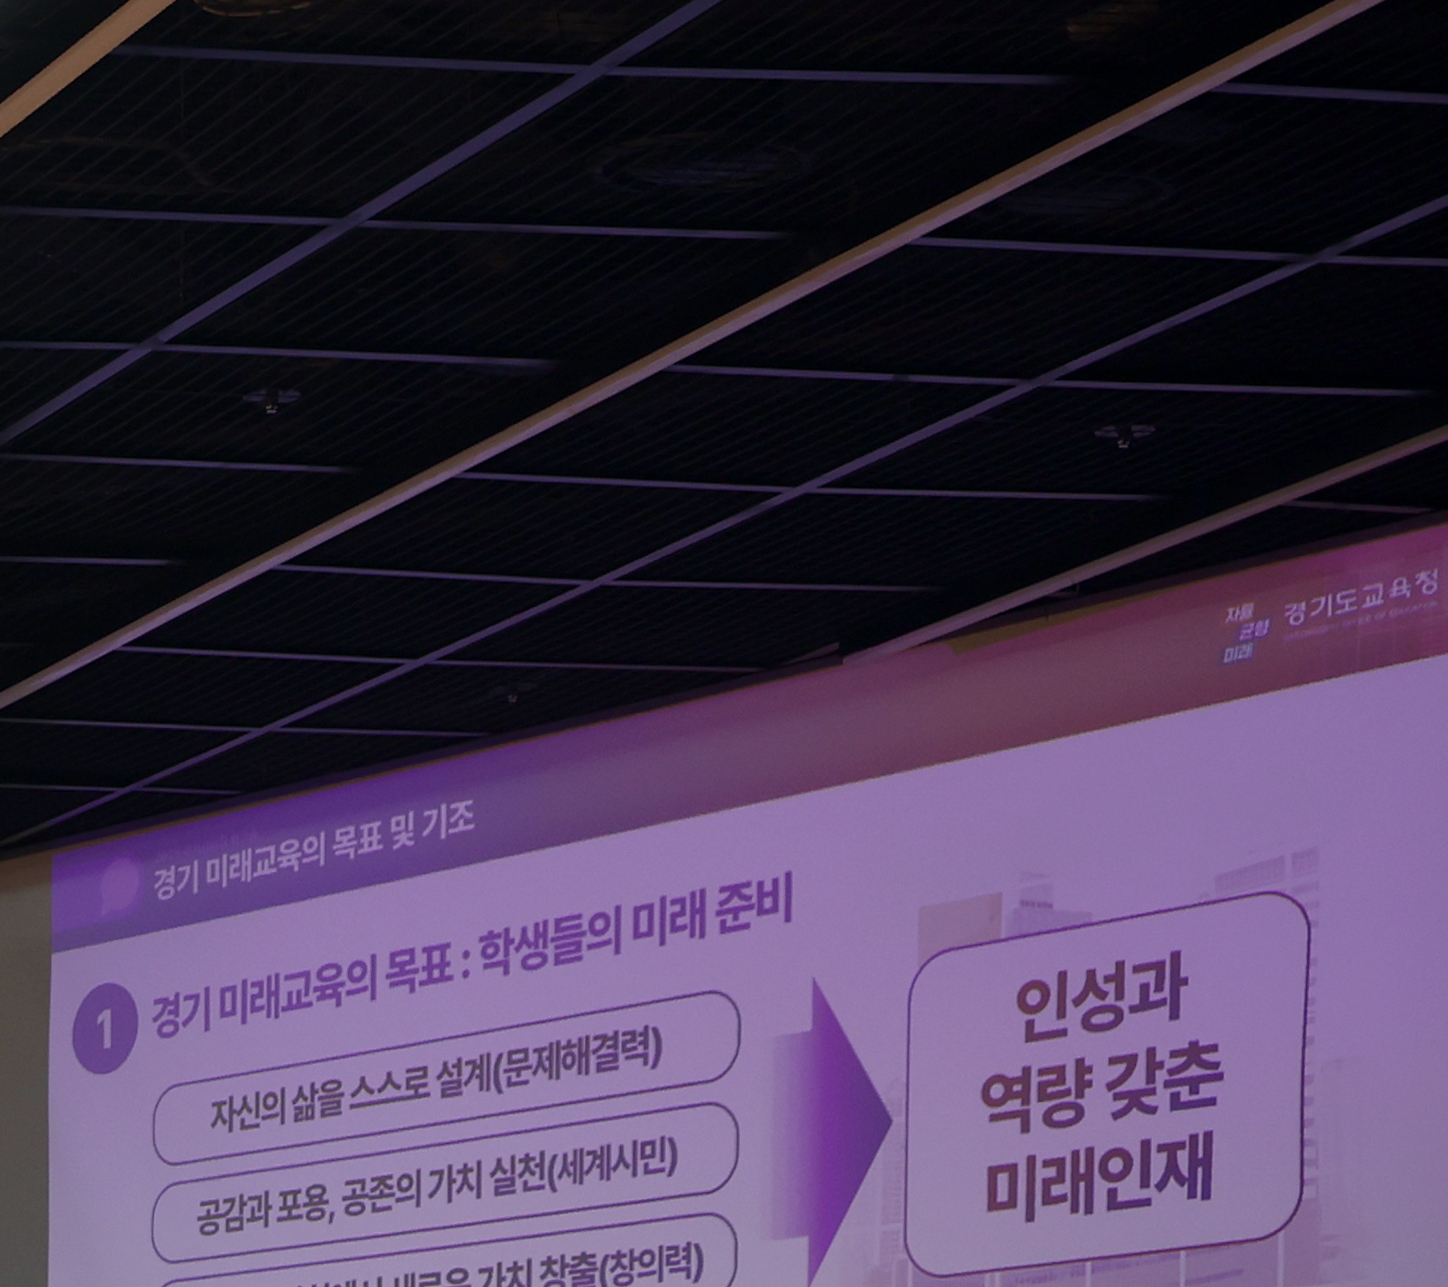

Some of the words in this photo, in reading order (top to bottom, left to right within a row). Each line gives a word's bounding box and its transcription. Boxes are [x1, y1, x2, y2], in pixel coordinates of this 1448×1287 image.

[1284, 568, 1438, 627] 경기도교육청
[154, 860, 199, 900] 경기
[206, 830, 326, 888] 미래교육의
[332, 827, 383, 868] 목표
[389, 817, 417, 851] 및
[423, 801, 476, 842] 기조
[152, 988, 211, 1040] 경기
[219, 953, 379, 1026] 미래교육의
[385, 941, 453, 986] 목표
[479, 904, 623, 977] 학생들의
[632, 889, 706, 947] 미래
[715, 870, 794, 932] 준비
[1017, 950, 1189, 1043] 인성과
[95, 1008, 113, 1049] 1
[210, 1086, 287, 1134] 자신의
[292, 1077, 345, 1125] 삶을
[349, 1067, 430, 1111] 스스로
[436, 1025, 663, 1096] 설계(문제해결력)
[981, 1055, 1094, 1135] 역량
[1105, 1040, 1225, 1121] 갖춘
[197, 1188, 273, 1237] 공감과
[276, 1177, 335, 1227] 포용,
[341, 1164, 422, 1218] 공존의
[428, 1158, 484, 1202] 가치
[489, 1133, 679, 1194] 실천(세계시민)
[986, 1130, 1215, 1224] 미래인재
